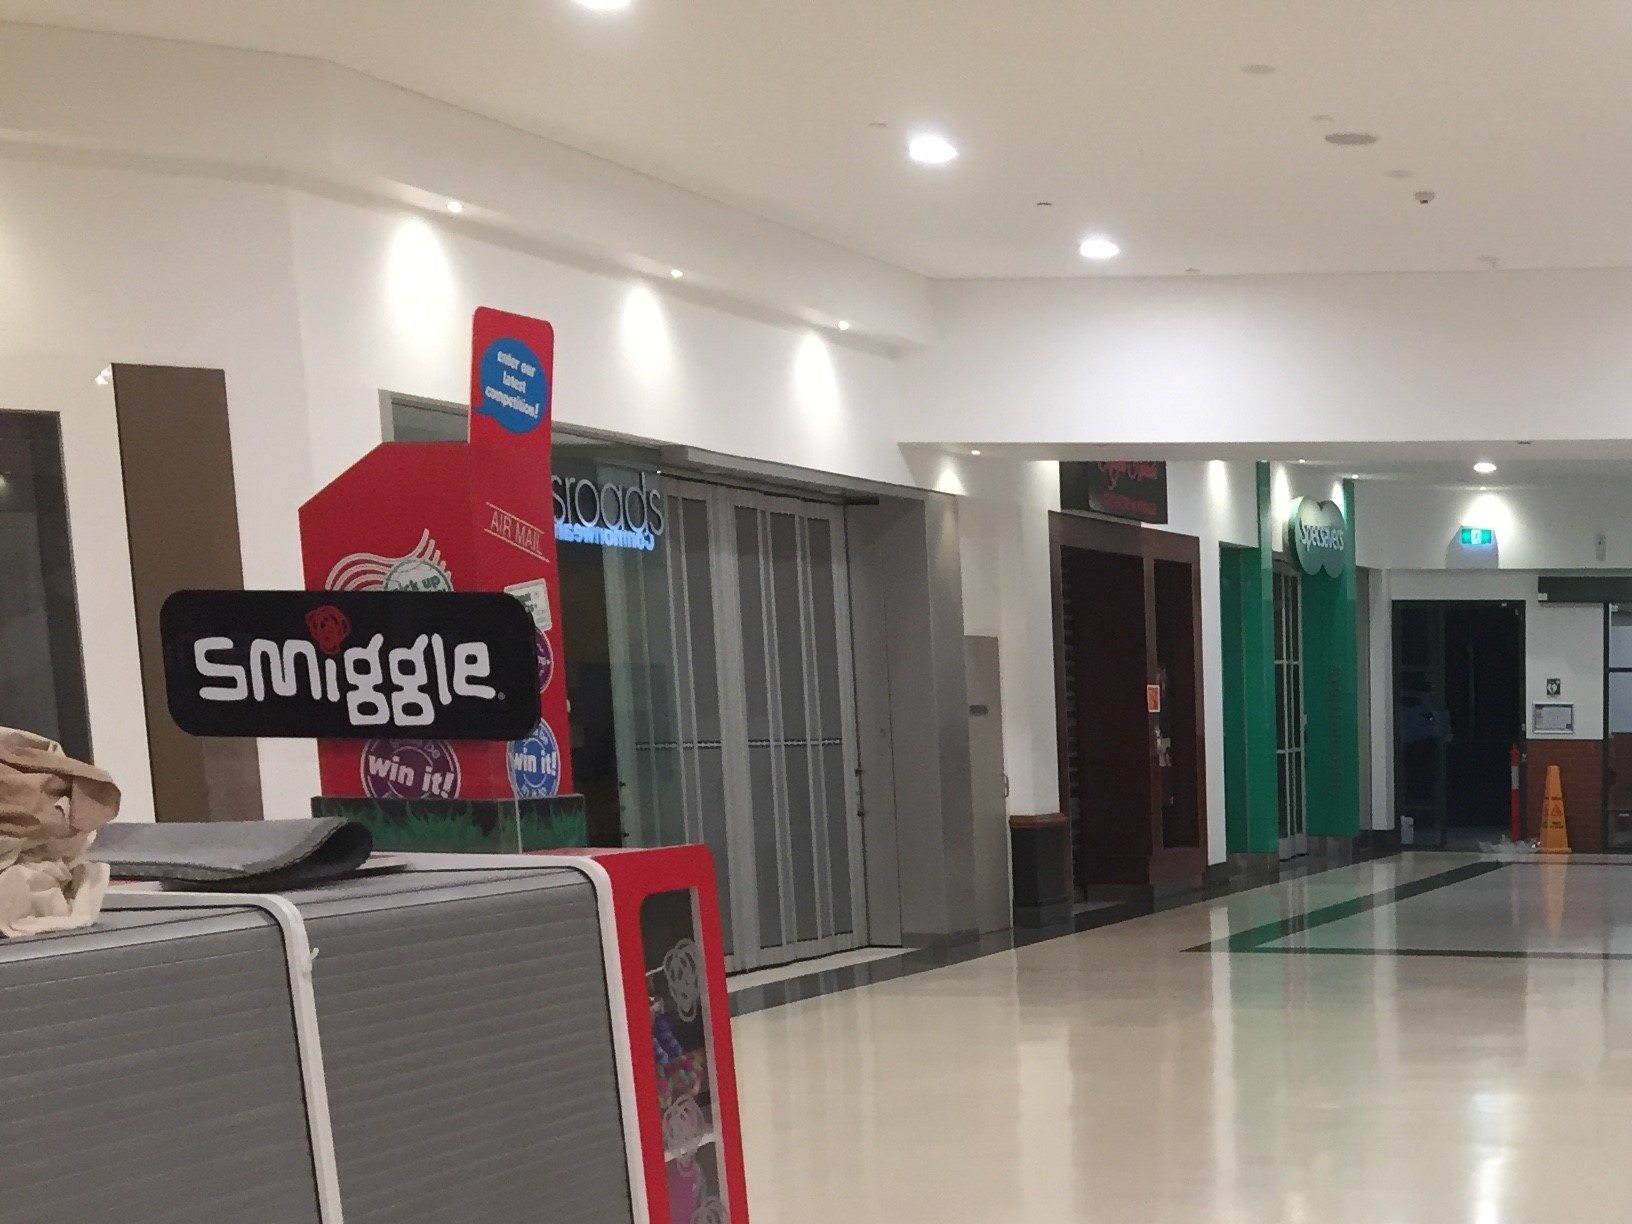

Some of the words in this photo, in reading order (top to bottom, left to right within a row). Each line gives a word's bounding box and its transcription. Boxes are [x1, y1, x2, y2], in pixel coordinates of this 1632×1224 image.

[502, 370, 527, 393] latest
[520, 362, 536, 378] our
[484, 385, 540, 419] competition!
[490, 510, 512, 537] AIR
[514, 521, 543, 556] MAIL
[368, 755, 415, 787] win
[421, 765, 455, 799] it!
[513, 747, 538, 785] win
[540, 749, 557, 791] it!
